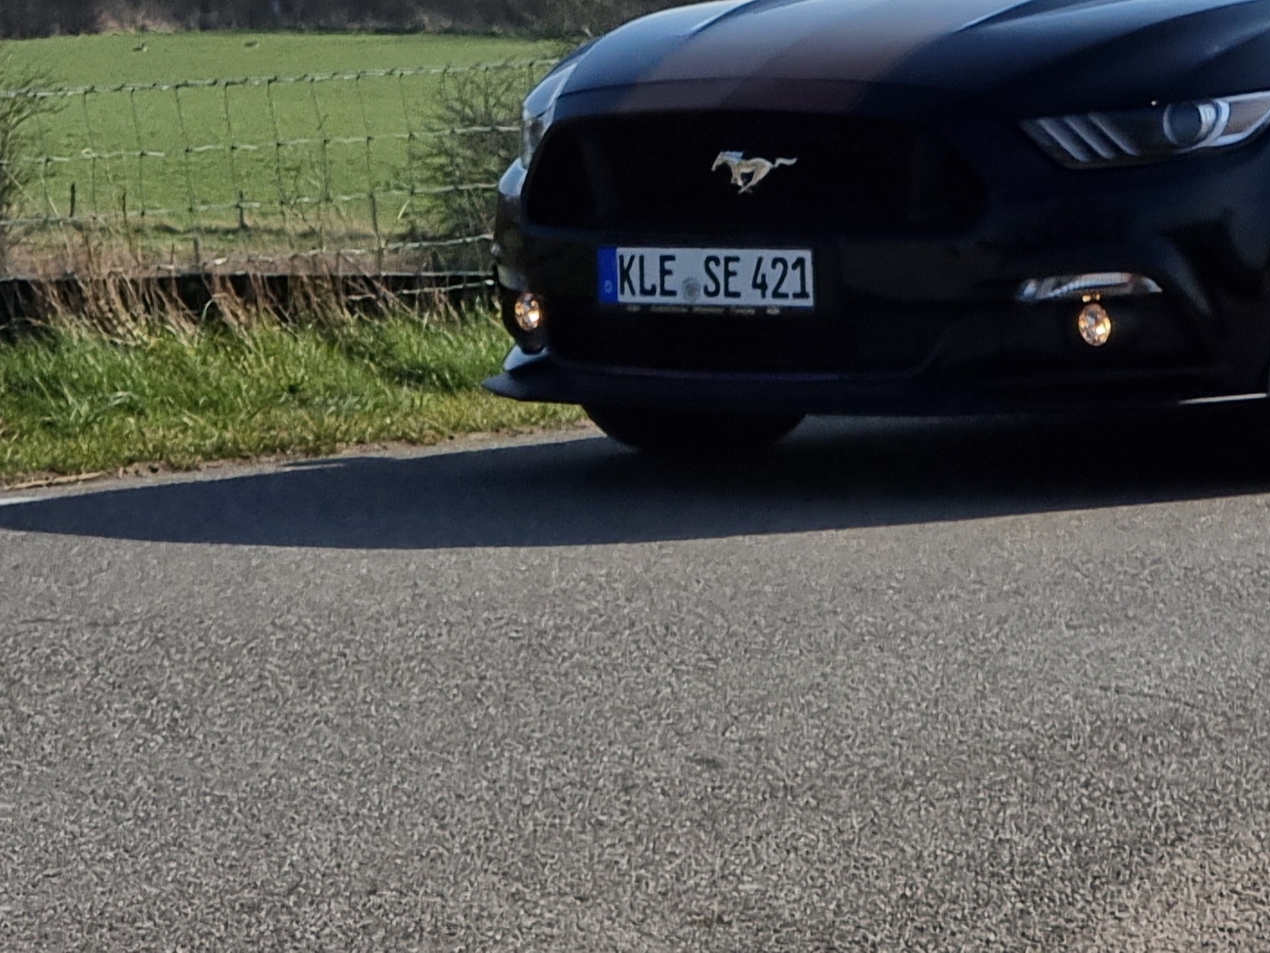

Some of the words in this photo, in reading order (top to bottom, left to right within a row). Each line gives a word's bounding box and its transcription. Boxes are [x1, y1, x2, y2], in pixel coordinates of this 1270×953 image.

[618, 254, 677, 297] KLE
[703, 255, 741, 298] SE
[751, 256, 810, 299] 421
